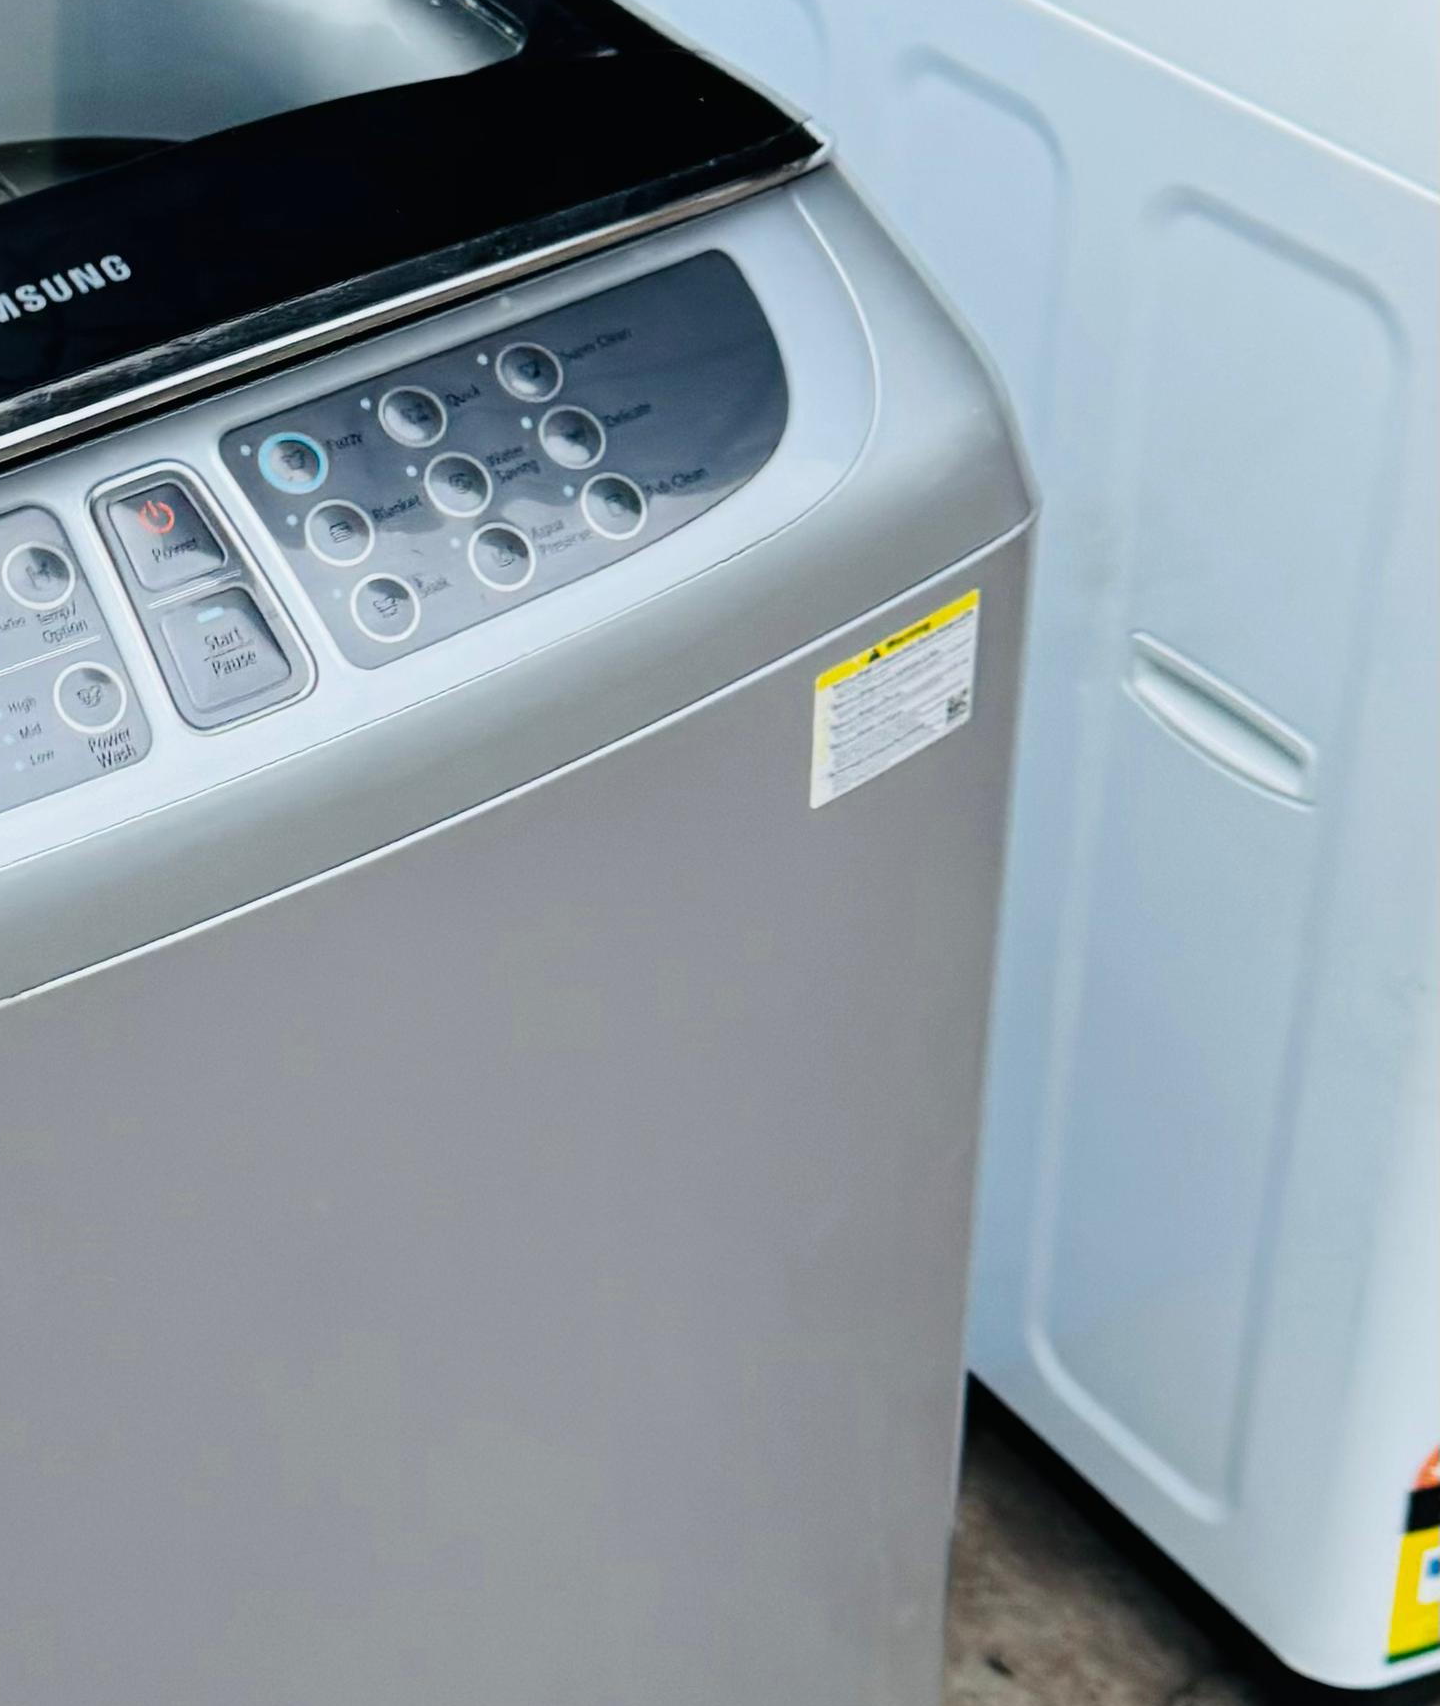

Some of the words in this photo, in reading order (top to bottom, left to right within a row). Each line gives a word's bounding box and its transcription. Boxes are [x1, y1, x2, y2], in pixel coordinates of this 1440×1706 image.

[203, 626, 243, 653] Start
[211, 649, 257, 679] Pause
[96, 743, 138, 769] Wash
